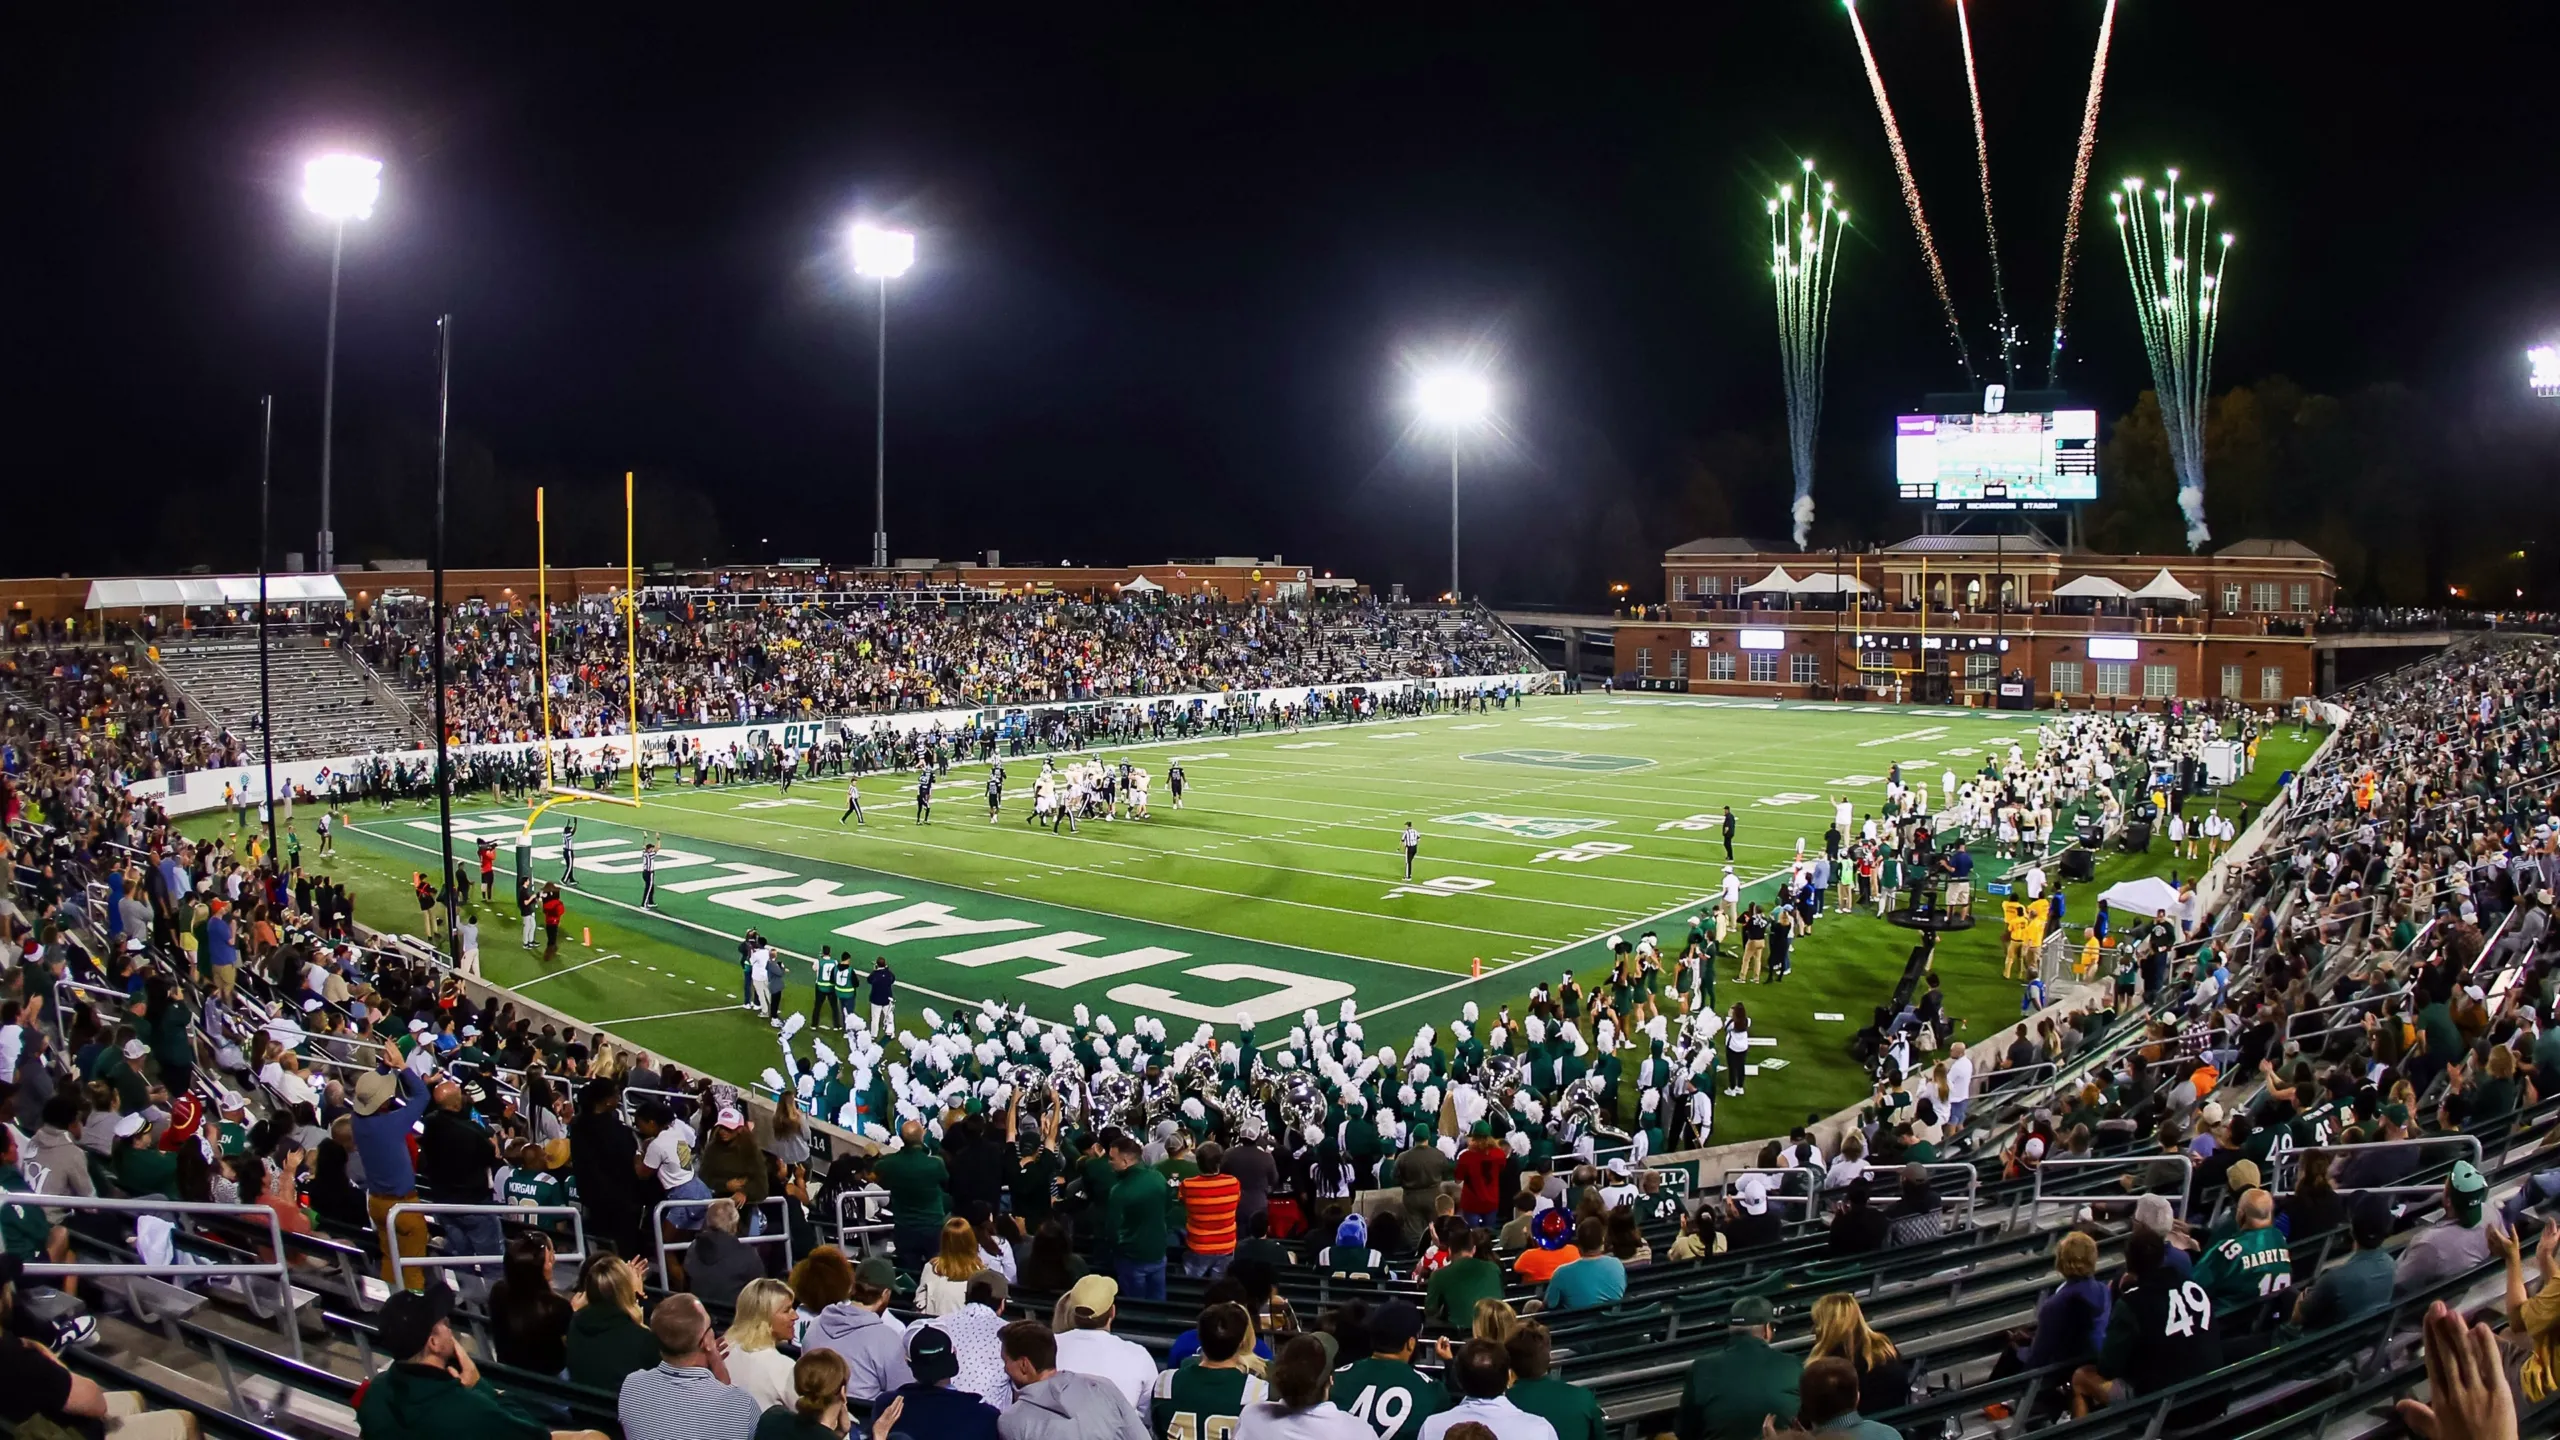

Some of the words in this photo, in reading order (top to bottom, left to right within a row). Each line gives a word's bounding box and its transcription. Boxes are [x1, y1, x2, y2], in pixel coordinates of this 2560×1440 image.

[642, 738, 667, 750] Model
[784, 724, 823, 749] CLT
[1535, 841, 1634, 863] 20
[1391, 876, 1496, 899] 10
[405, 815, 1356, 1024] CHARLOTTE
[808, 1136, 825, 1152] 114
[509, 1182, 537, 1196] MORGAN
[1659, 1172, 1686, 1187] 112
[2218, 1239, 2243, 1260] 19
[2242, 1249, 2278, 1270] BARRY
[2165, 1280, 2212, 1338] 49
[1348, 1384, 1413, 1440] 49
